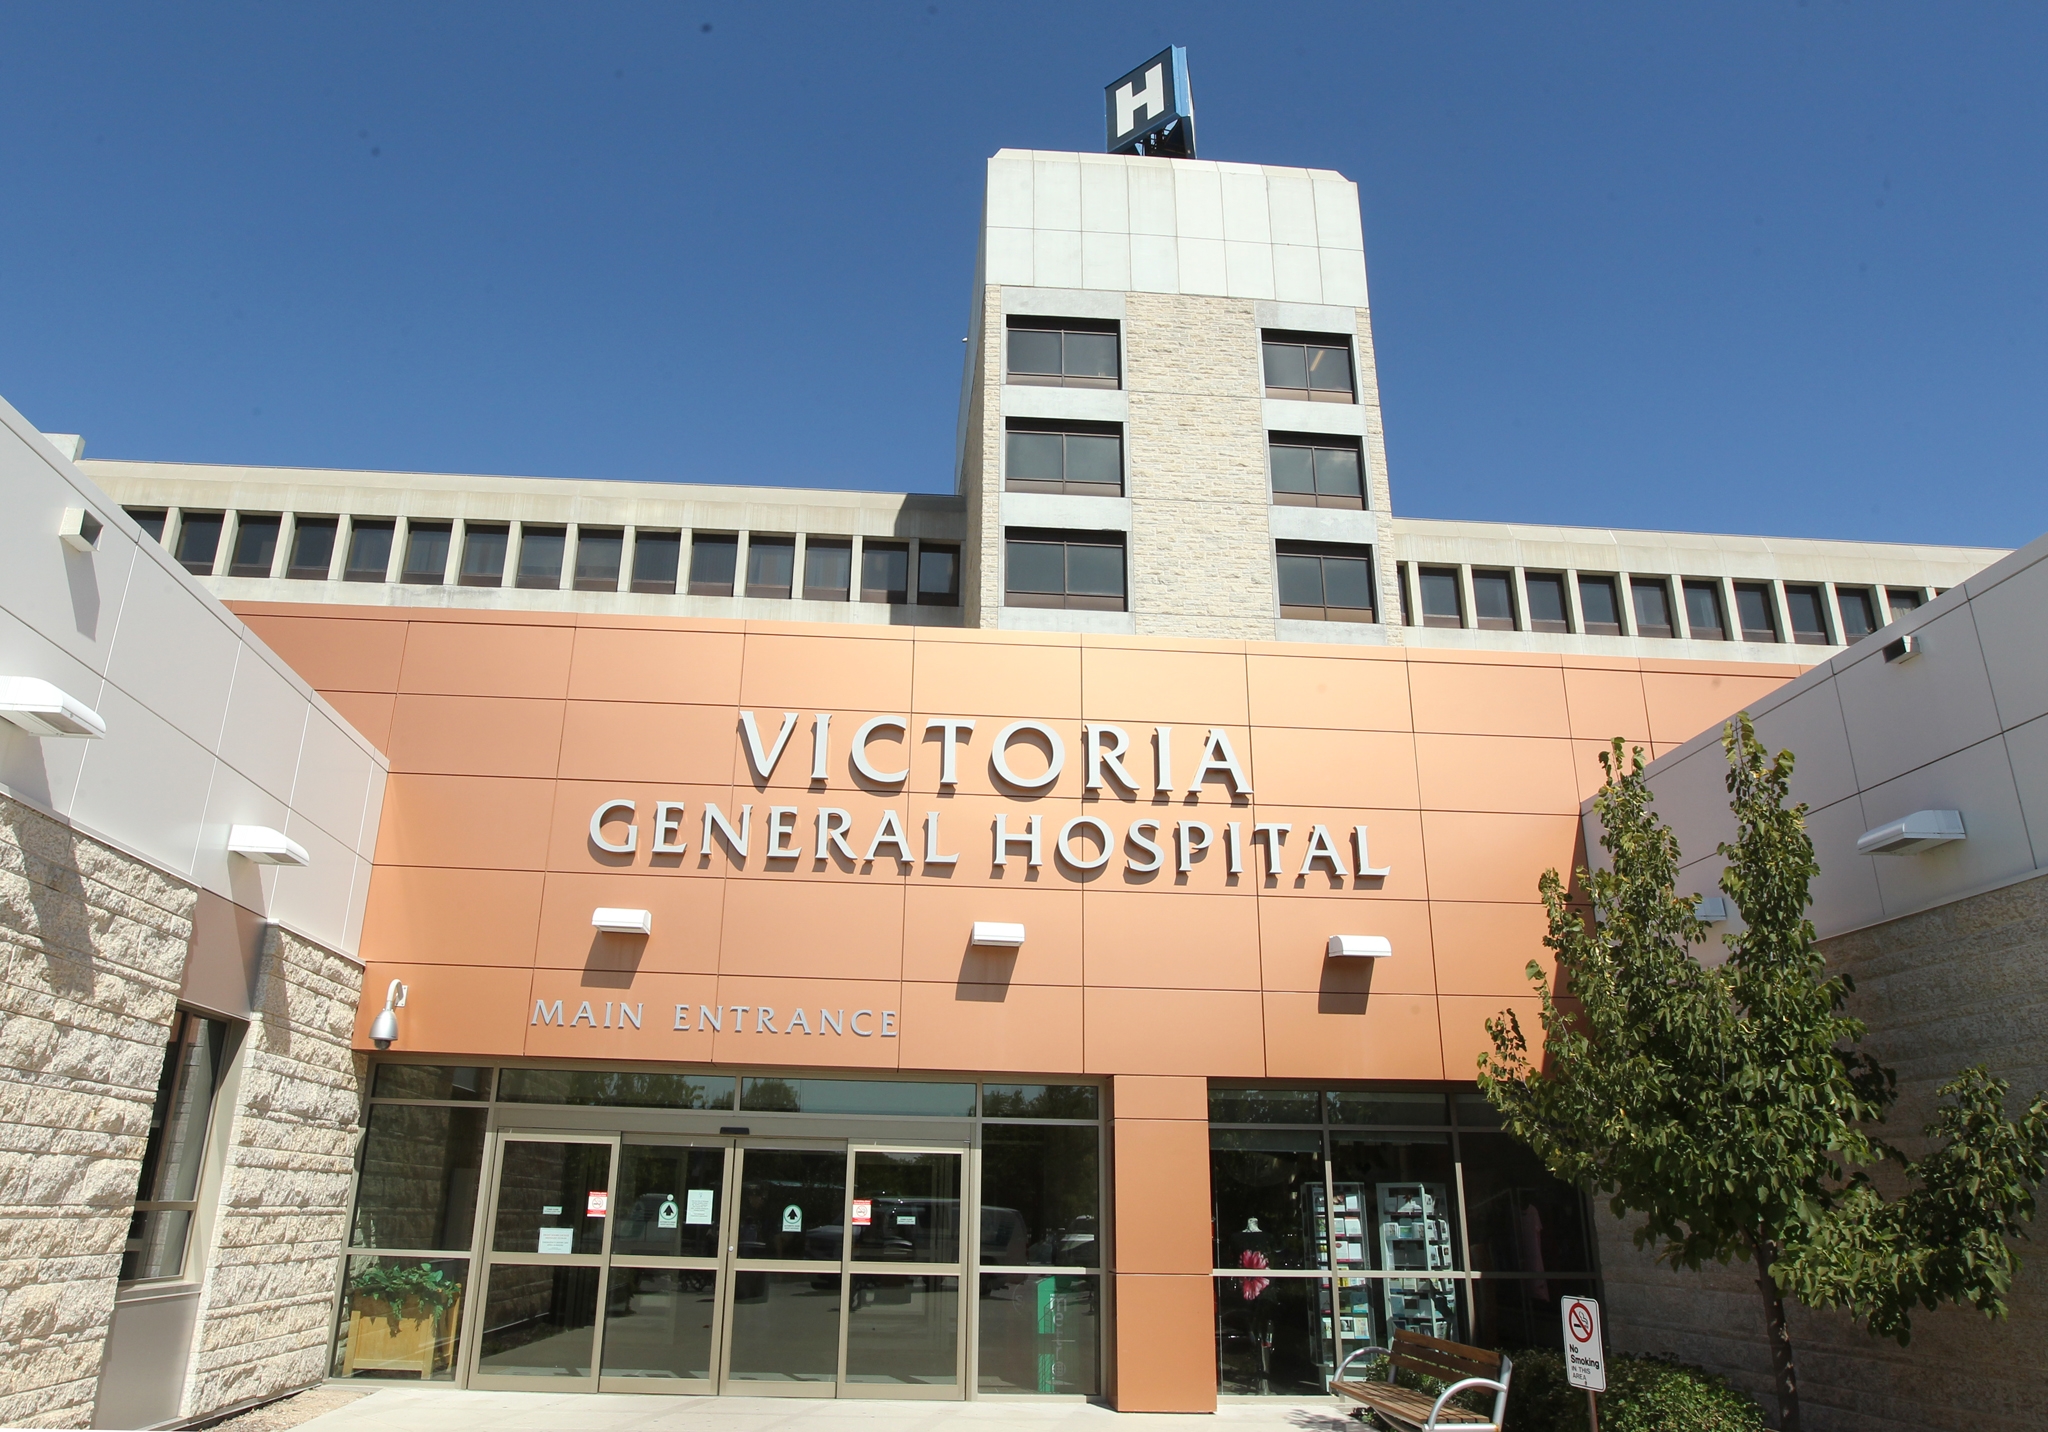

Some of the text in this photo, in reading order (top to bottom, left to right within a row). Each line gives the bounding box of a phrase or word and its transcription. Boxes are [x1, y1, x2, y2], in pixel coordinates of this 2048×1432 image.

[1115, 62, 1165, 138] H
[739, 710, 1253, 795] VICTORIA
[589, 799, 1391, 879] GENERAL HOSPITAL
[530, 999, 899, 1037] MAIN ENTRANCE
[1569, 1344, 1578, 1353] No
[1571, 1354, 1599, 1369] Smoking
[1573, 1372, 1586, 1380] AREA
